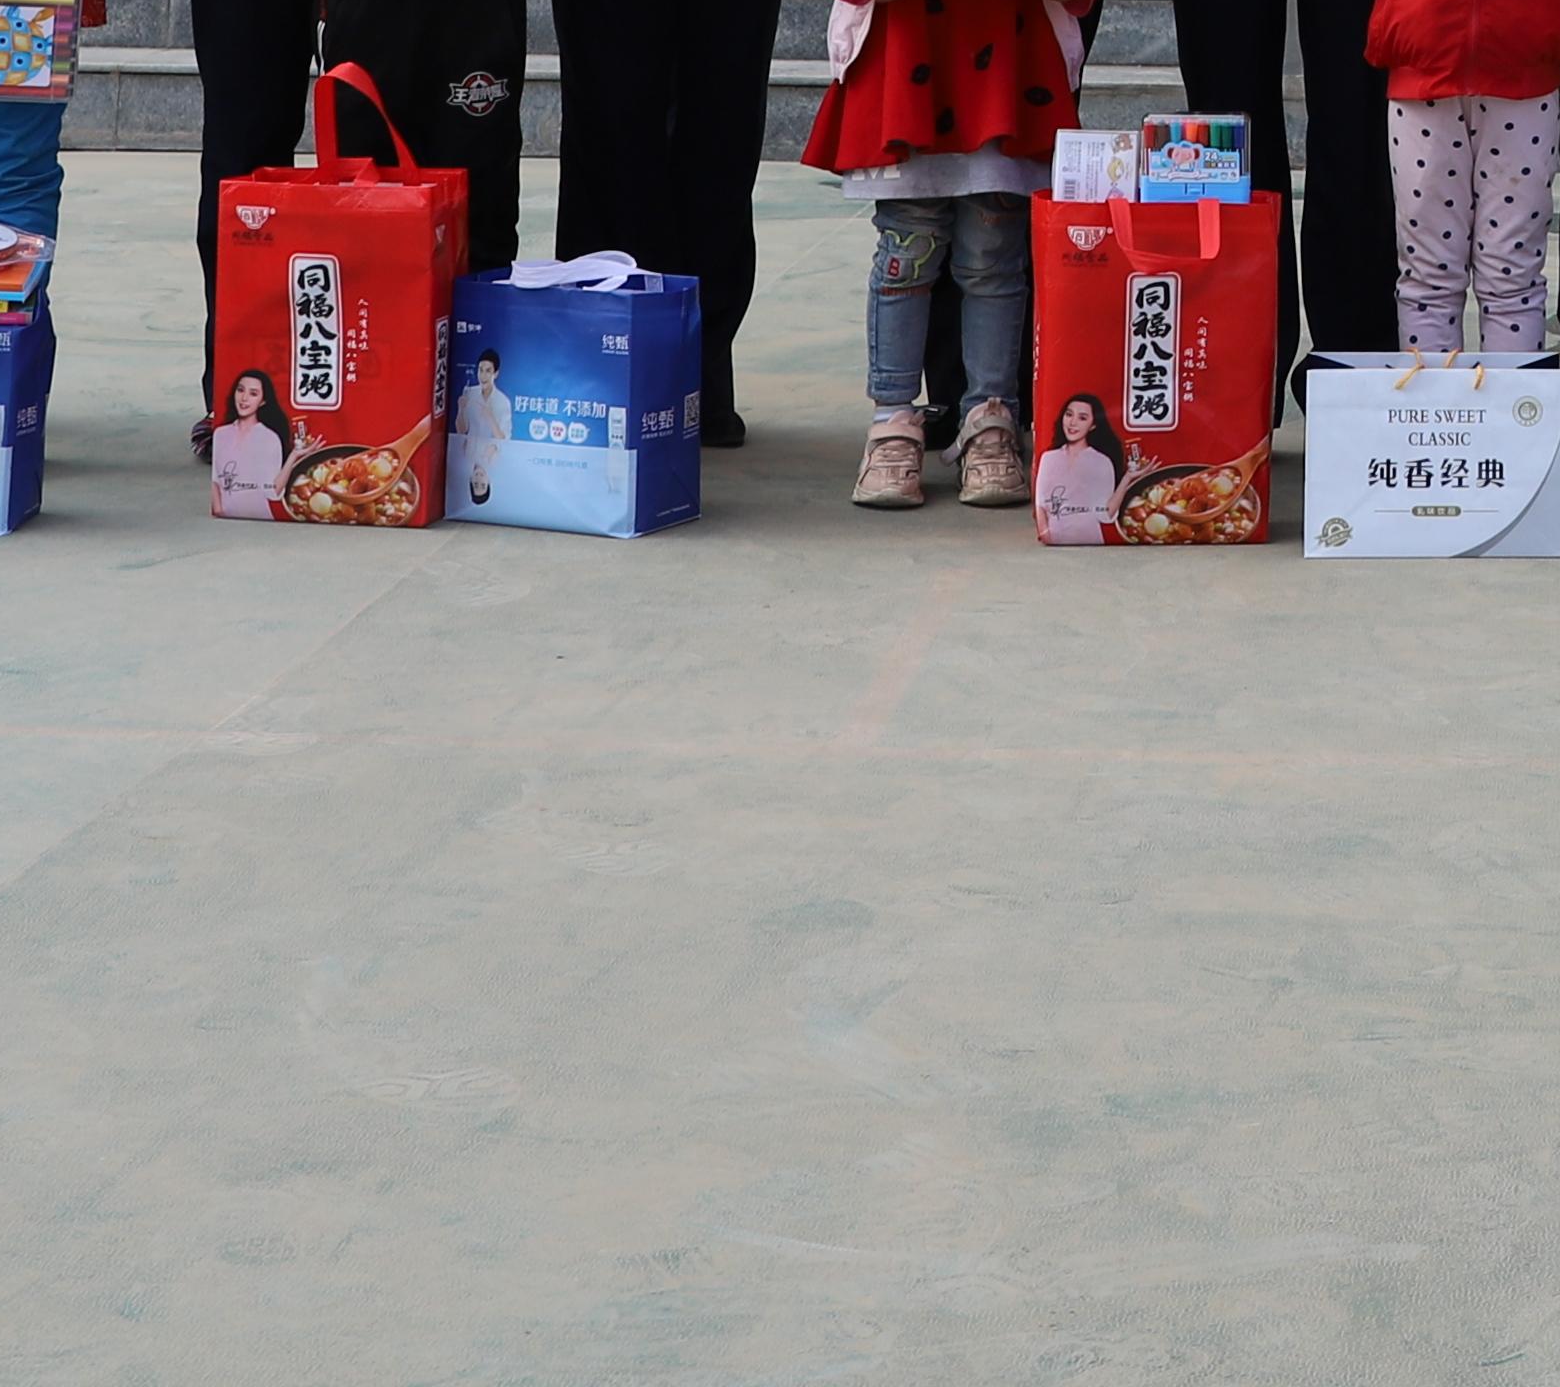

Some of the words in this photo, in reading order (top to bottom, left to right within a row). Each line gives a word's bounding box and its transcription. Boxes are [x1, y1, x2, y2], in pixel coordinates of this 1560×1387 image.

[296, 263, 337, 400] 同福八宝粥
[1131, 282, 1173, 422] 同福八宝粥
[514, 395, 558, 414] 好味道
[562, 400, 607, 419] 不添加
[1388, 409, 1429, 424] PURE
[1435, 409, 1486, 424] SWEET
[1408, 432, 1471, 446] CLASSIC
[1368, 457, 1507, 489] 纯香经典
